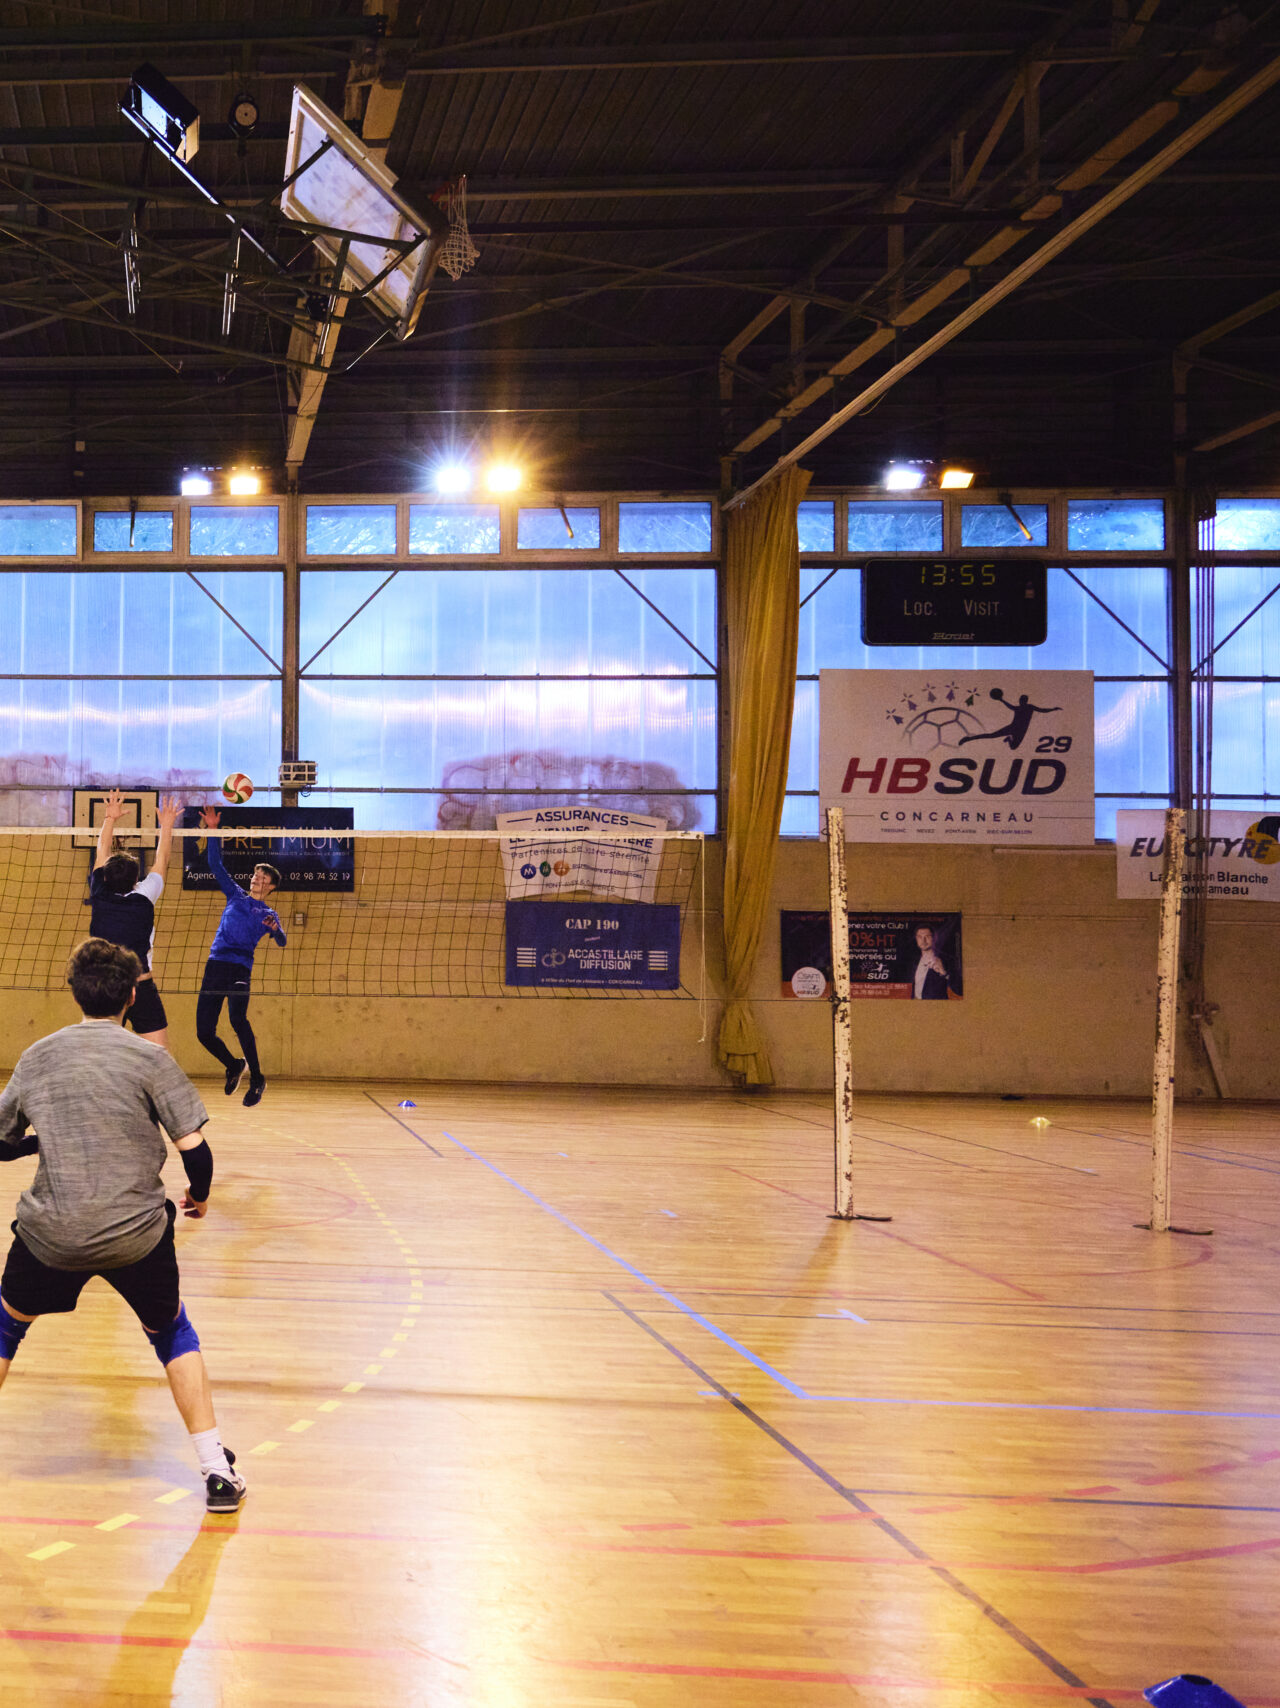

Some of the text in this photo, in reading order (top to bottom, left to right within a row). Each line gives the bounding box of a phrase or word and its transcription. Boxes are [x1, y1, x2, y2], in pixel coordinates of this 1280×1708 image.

[921, 564, 996, 586] 13:55
[1035, 736, 1072, 753] 29
[841, 757, 1067, 796] HBSUD
[535, 810, 629, 826] ASSURANCES
[880, 811, 1033, 823] CONCARNEAU
[290, 872, 300, 881] 02
[303, 872, 314, 881] 98
[317, 872, 326, 881] 74
[329, 872, 338, 881] 52
[342, 872, 351, 881] 19
[1217, 872, 1269, 884] Blanche
[565, 918, 619, 930] CAP 190
[568, 948, 643, 960] ACCASTILLAGE
[580, 959, 631, 970] DIFFUSION
